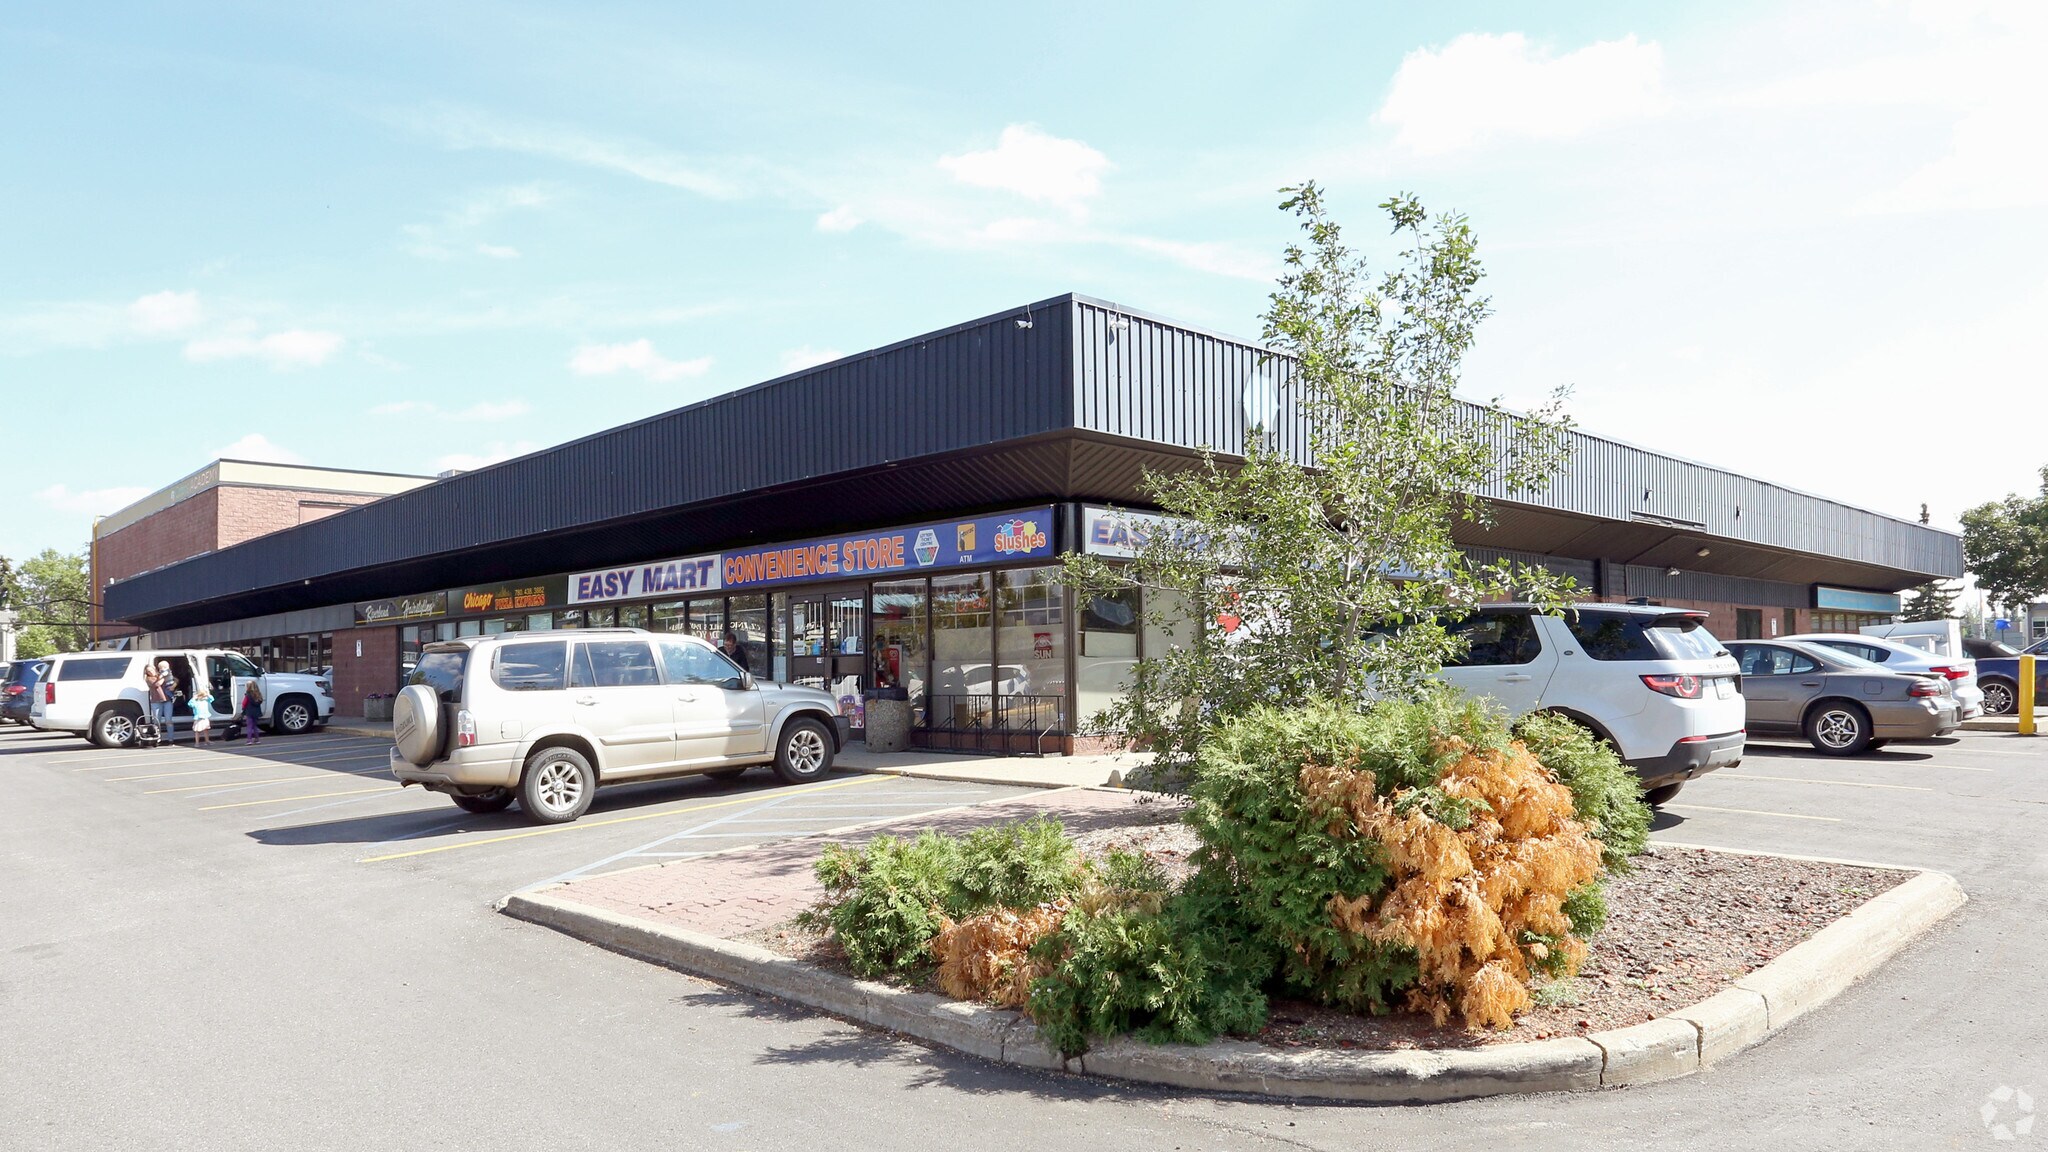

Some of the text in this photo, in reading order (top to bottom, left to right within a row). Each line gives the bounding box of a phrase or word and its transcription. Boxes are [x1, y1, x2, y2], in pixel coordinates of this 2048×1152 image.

[994, 531, 1047, 552] Slushes
[725, 535, 905, 585] CONVENIENCE STORE
[959, 554, 973, 563] ATM
[577, 559, 715, 601] EASY MART
[464, 592, 494, 611] Chicago
[495, 593, 545, 611] PIZZA EXPRESS
[1034, 650, 1052, 659] SUN
